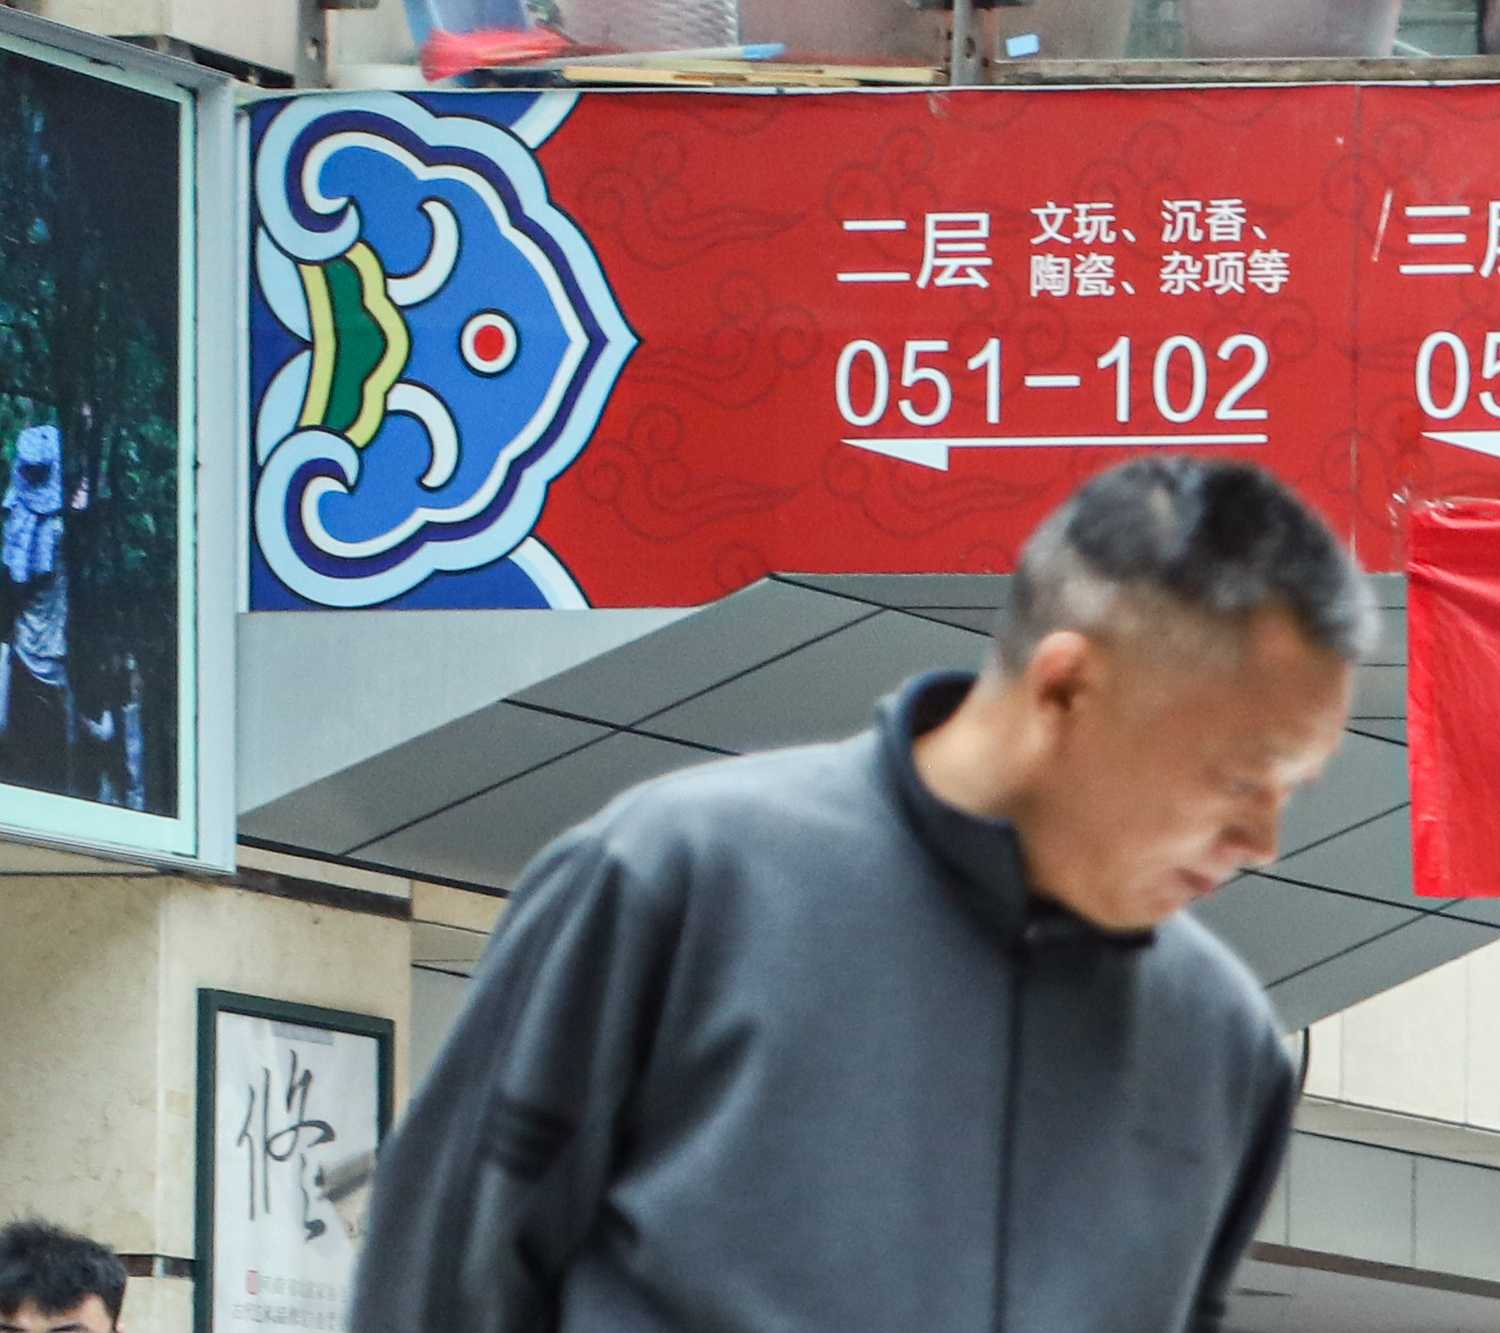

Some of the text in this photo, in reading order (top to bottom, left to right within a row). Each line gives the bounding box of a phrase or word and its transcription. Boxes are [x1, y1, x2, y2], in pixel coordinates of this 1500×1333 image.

[836, 212, 993, 289] 二层
[1030, 248, 1291, 298] 陶瓷、杂项等
[835, 333, 1270, 427] 051-102
